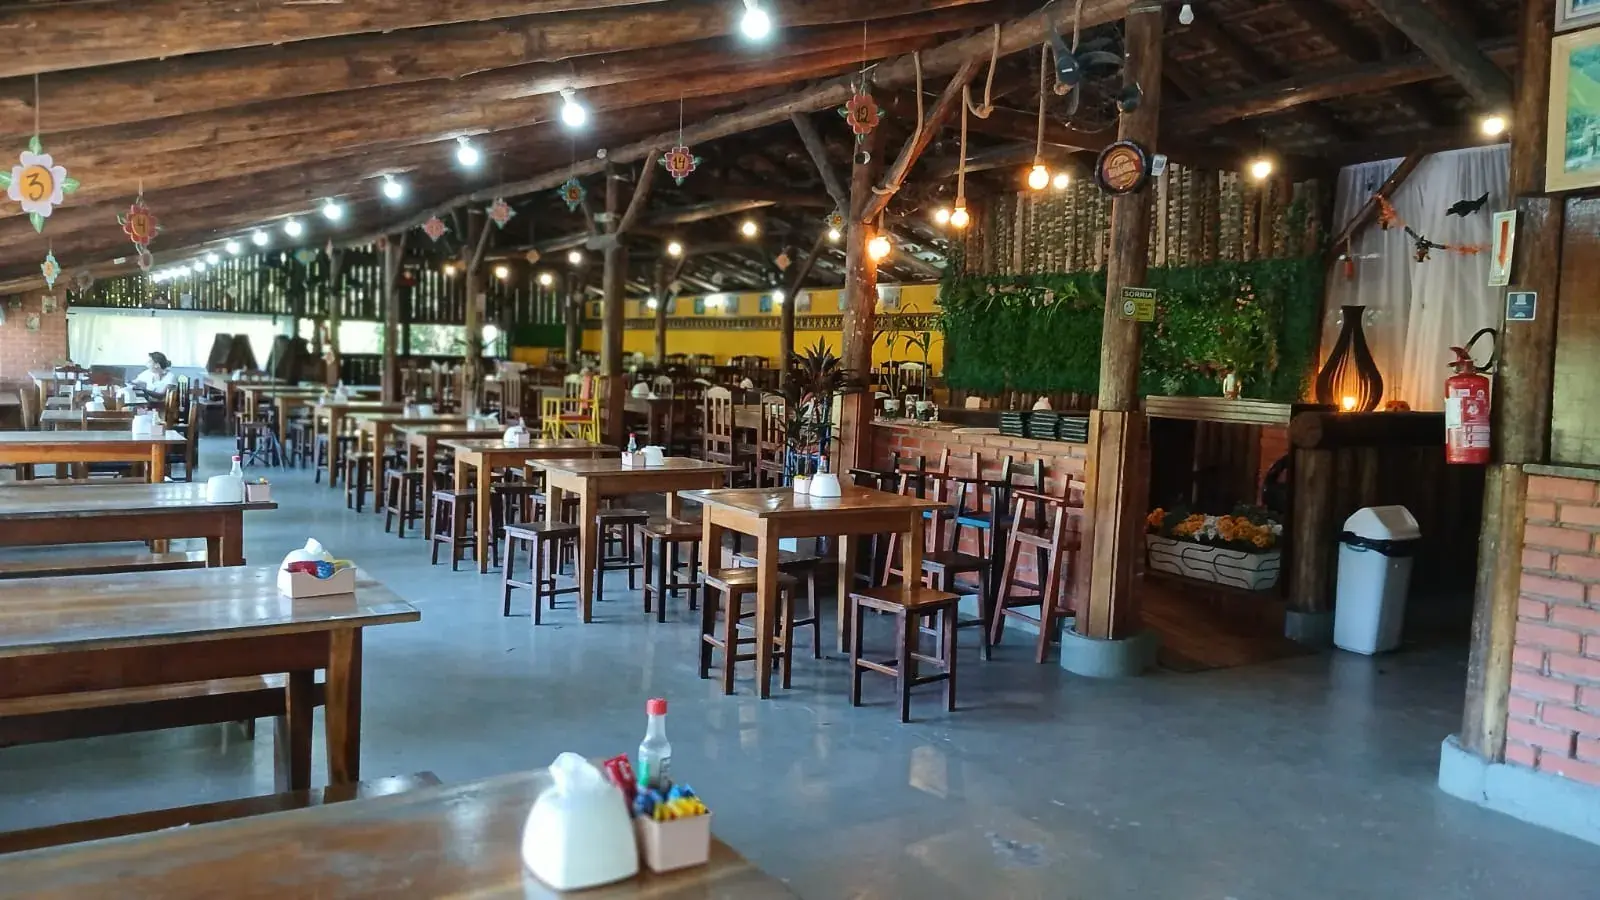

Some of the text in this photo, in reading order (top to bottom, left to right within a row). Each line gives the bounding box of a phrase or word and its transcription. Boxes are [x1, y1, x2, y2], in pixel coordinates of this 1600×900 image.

[855, 105, 869, 122] 12
[673, 156, 686, 169] 14
[26, 172, 44, 201] 3
[136, 217, 146, 233] 4
